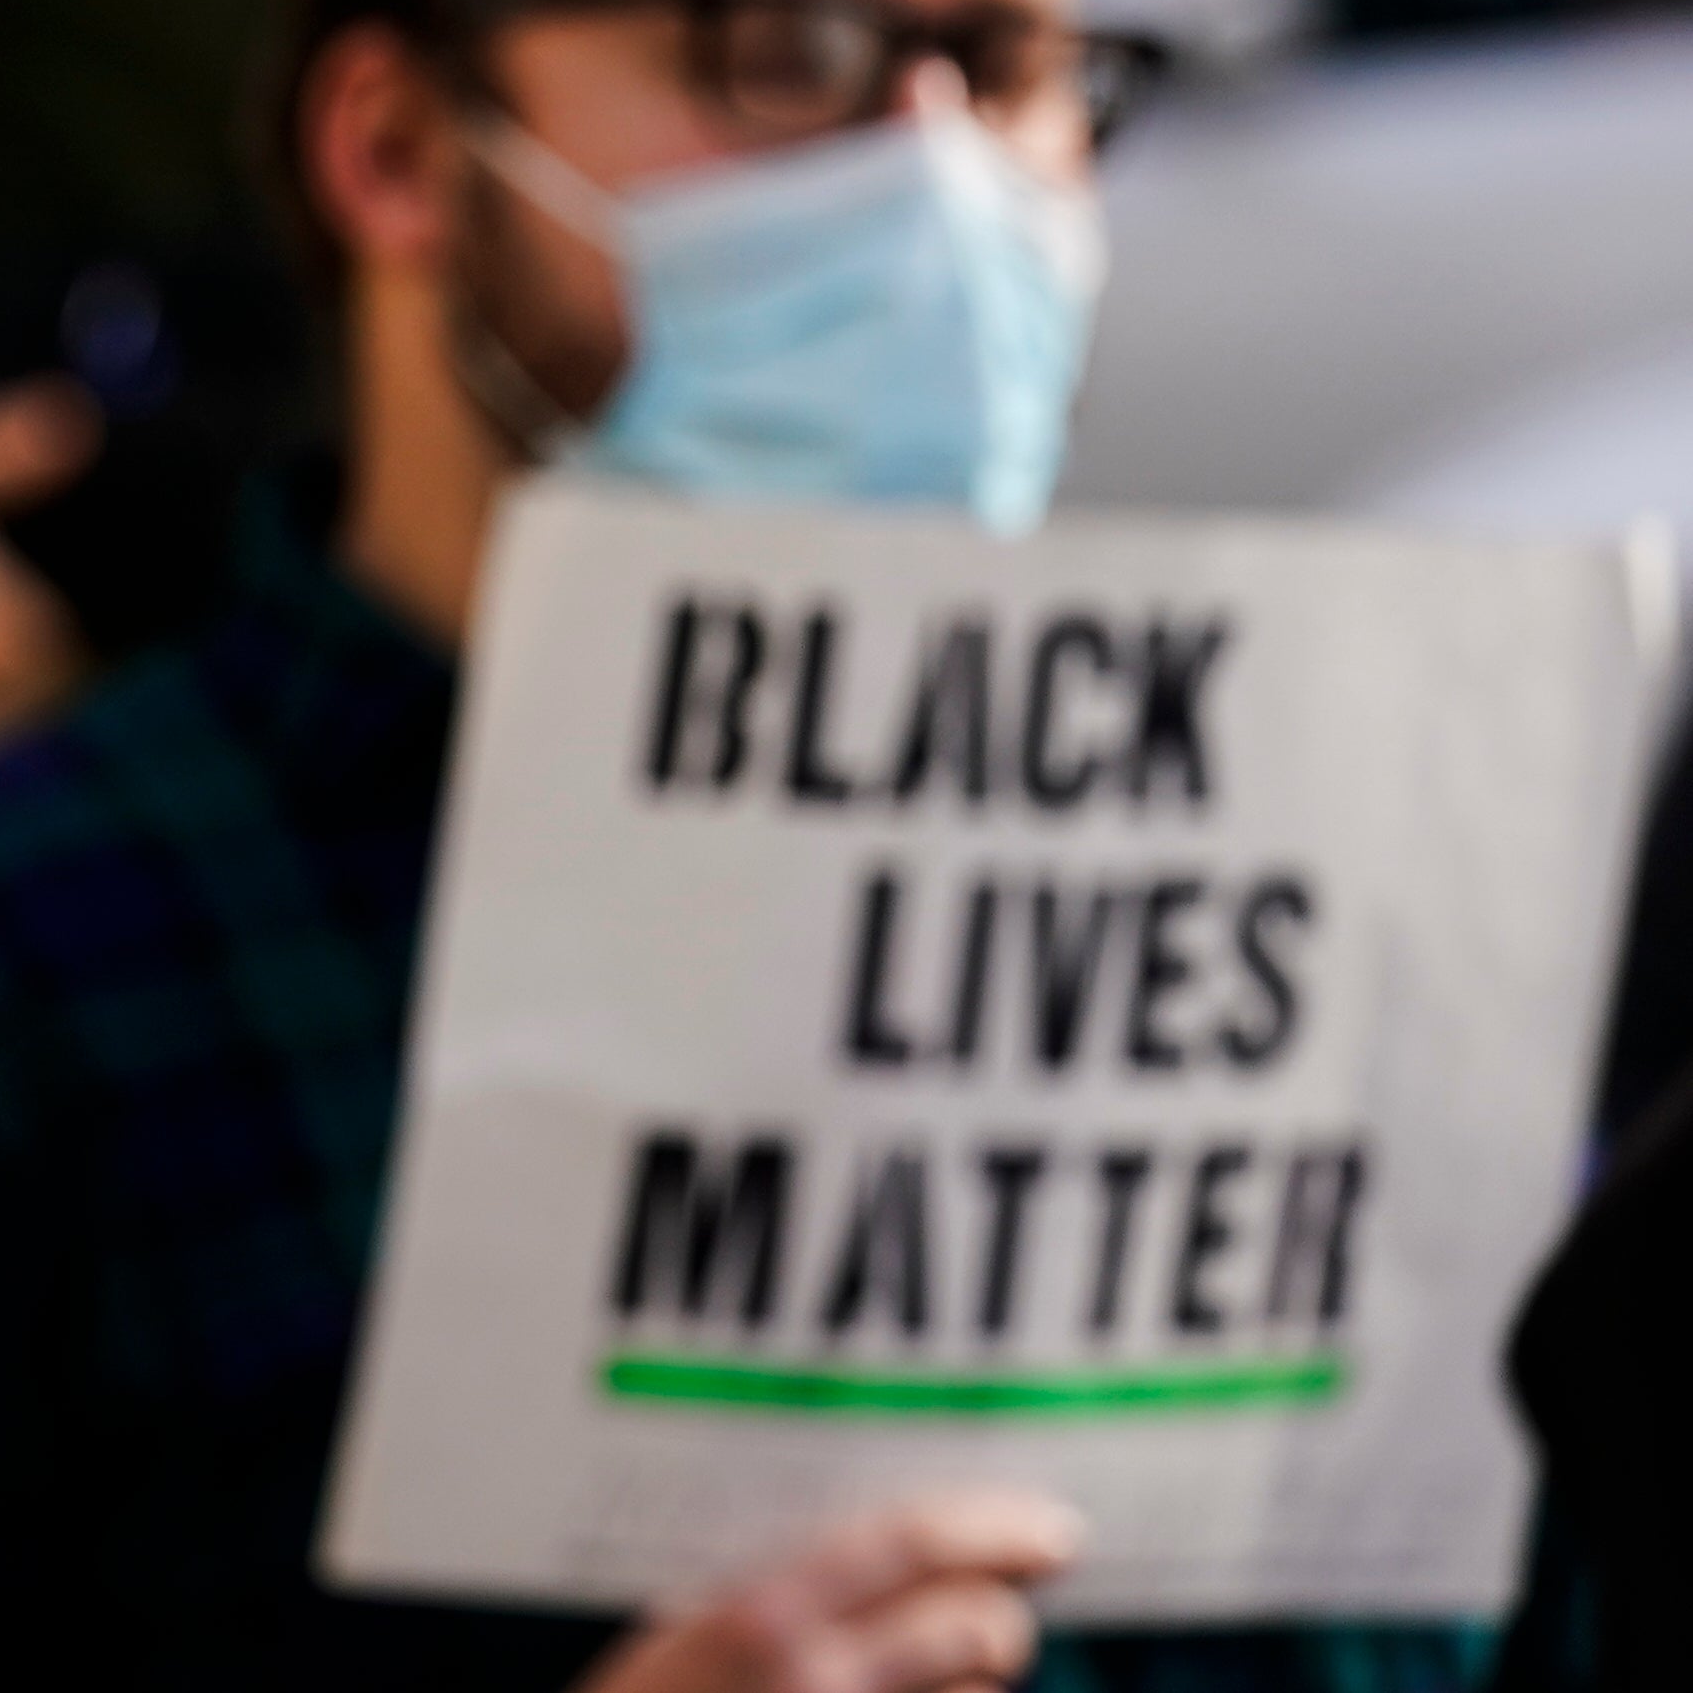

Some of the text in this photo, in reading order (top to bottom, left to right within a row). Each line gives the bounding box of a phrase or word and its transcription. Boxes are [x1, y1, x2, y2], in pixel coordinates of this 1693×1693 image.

[642, 592, 1229, 817] BLACK
[839, 867, 1314, 1077] LIVES
[609, 1128, 1369, 1344] MATTER
